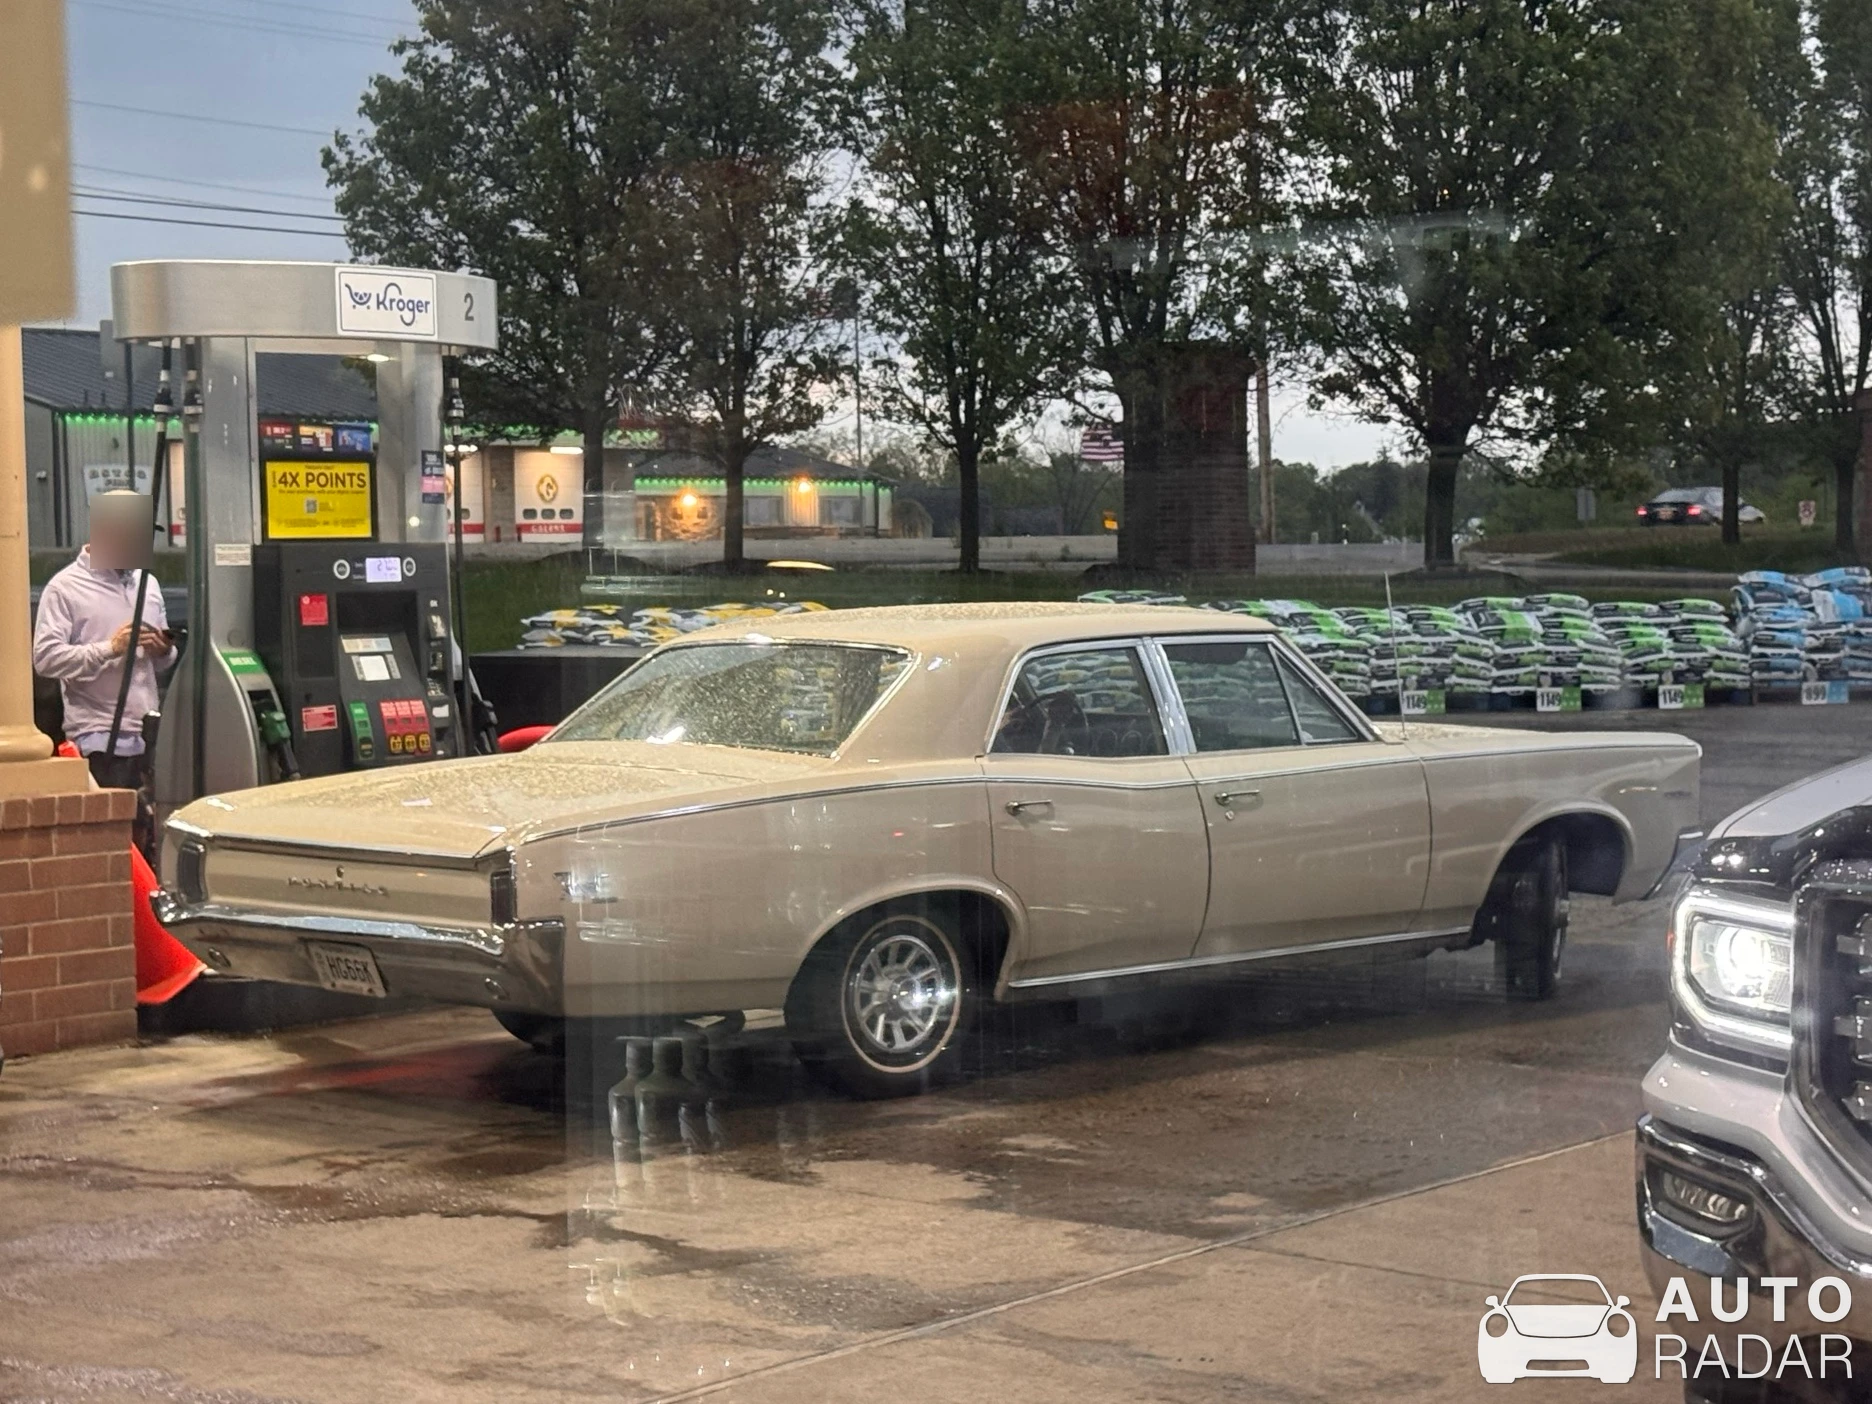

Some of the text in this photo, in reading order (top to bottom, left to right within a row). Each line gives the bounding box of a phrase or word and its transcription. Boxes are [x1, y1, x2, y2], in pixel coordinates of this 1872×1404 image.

[376, 282, 431, 327] Kroger
[463, 292, 475, 321] 2
[278, 471, 300, 488] 4X
[305, 471, 367, 489] POINTS
